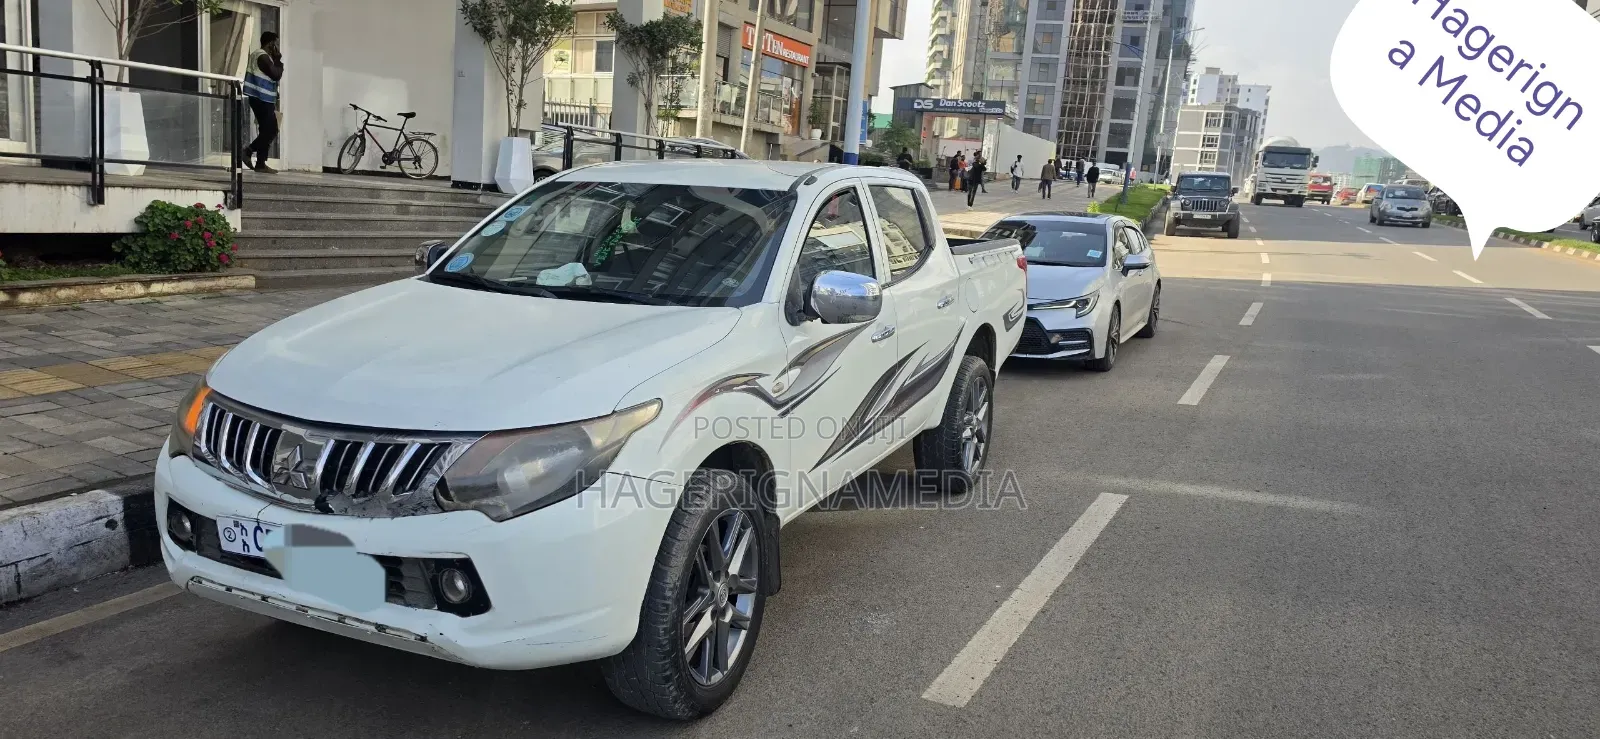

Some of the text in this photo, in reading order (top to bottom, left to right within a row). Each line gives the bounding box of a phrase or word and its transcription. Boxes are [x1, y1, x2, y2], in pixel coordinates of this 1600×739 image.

[765, 33, 783, 56] TEN
[783, 48, 809, 64] RESTAURANT
[939, 98, 956, 107] Dan
[957, 99, 986, 108] Scootz
